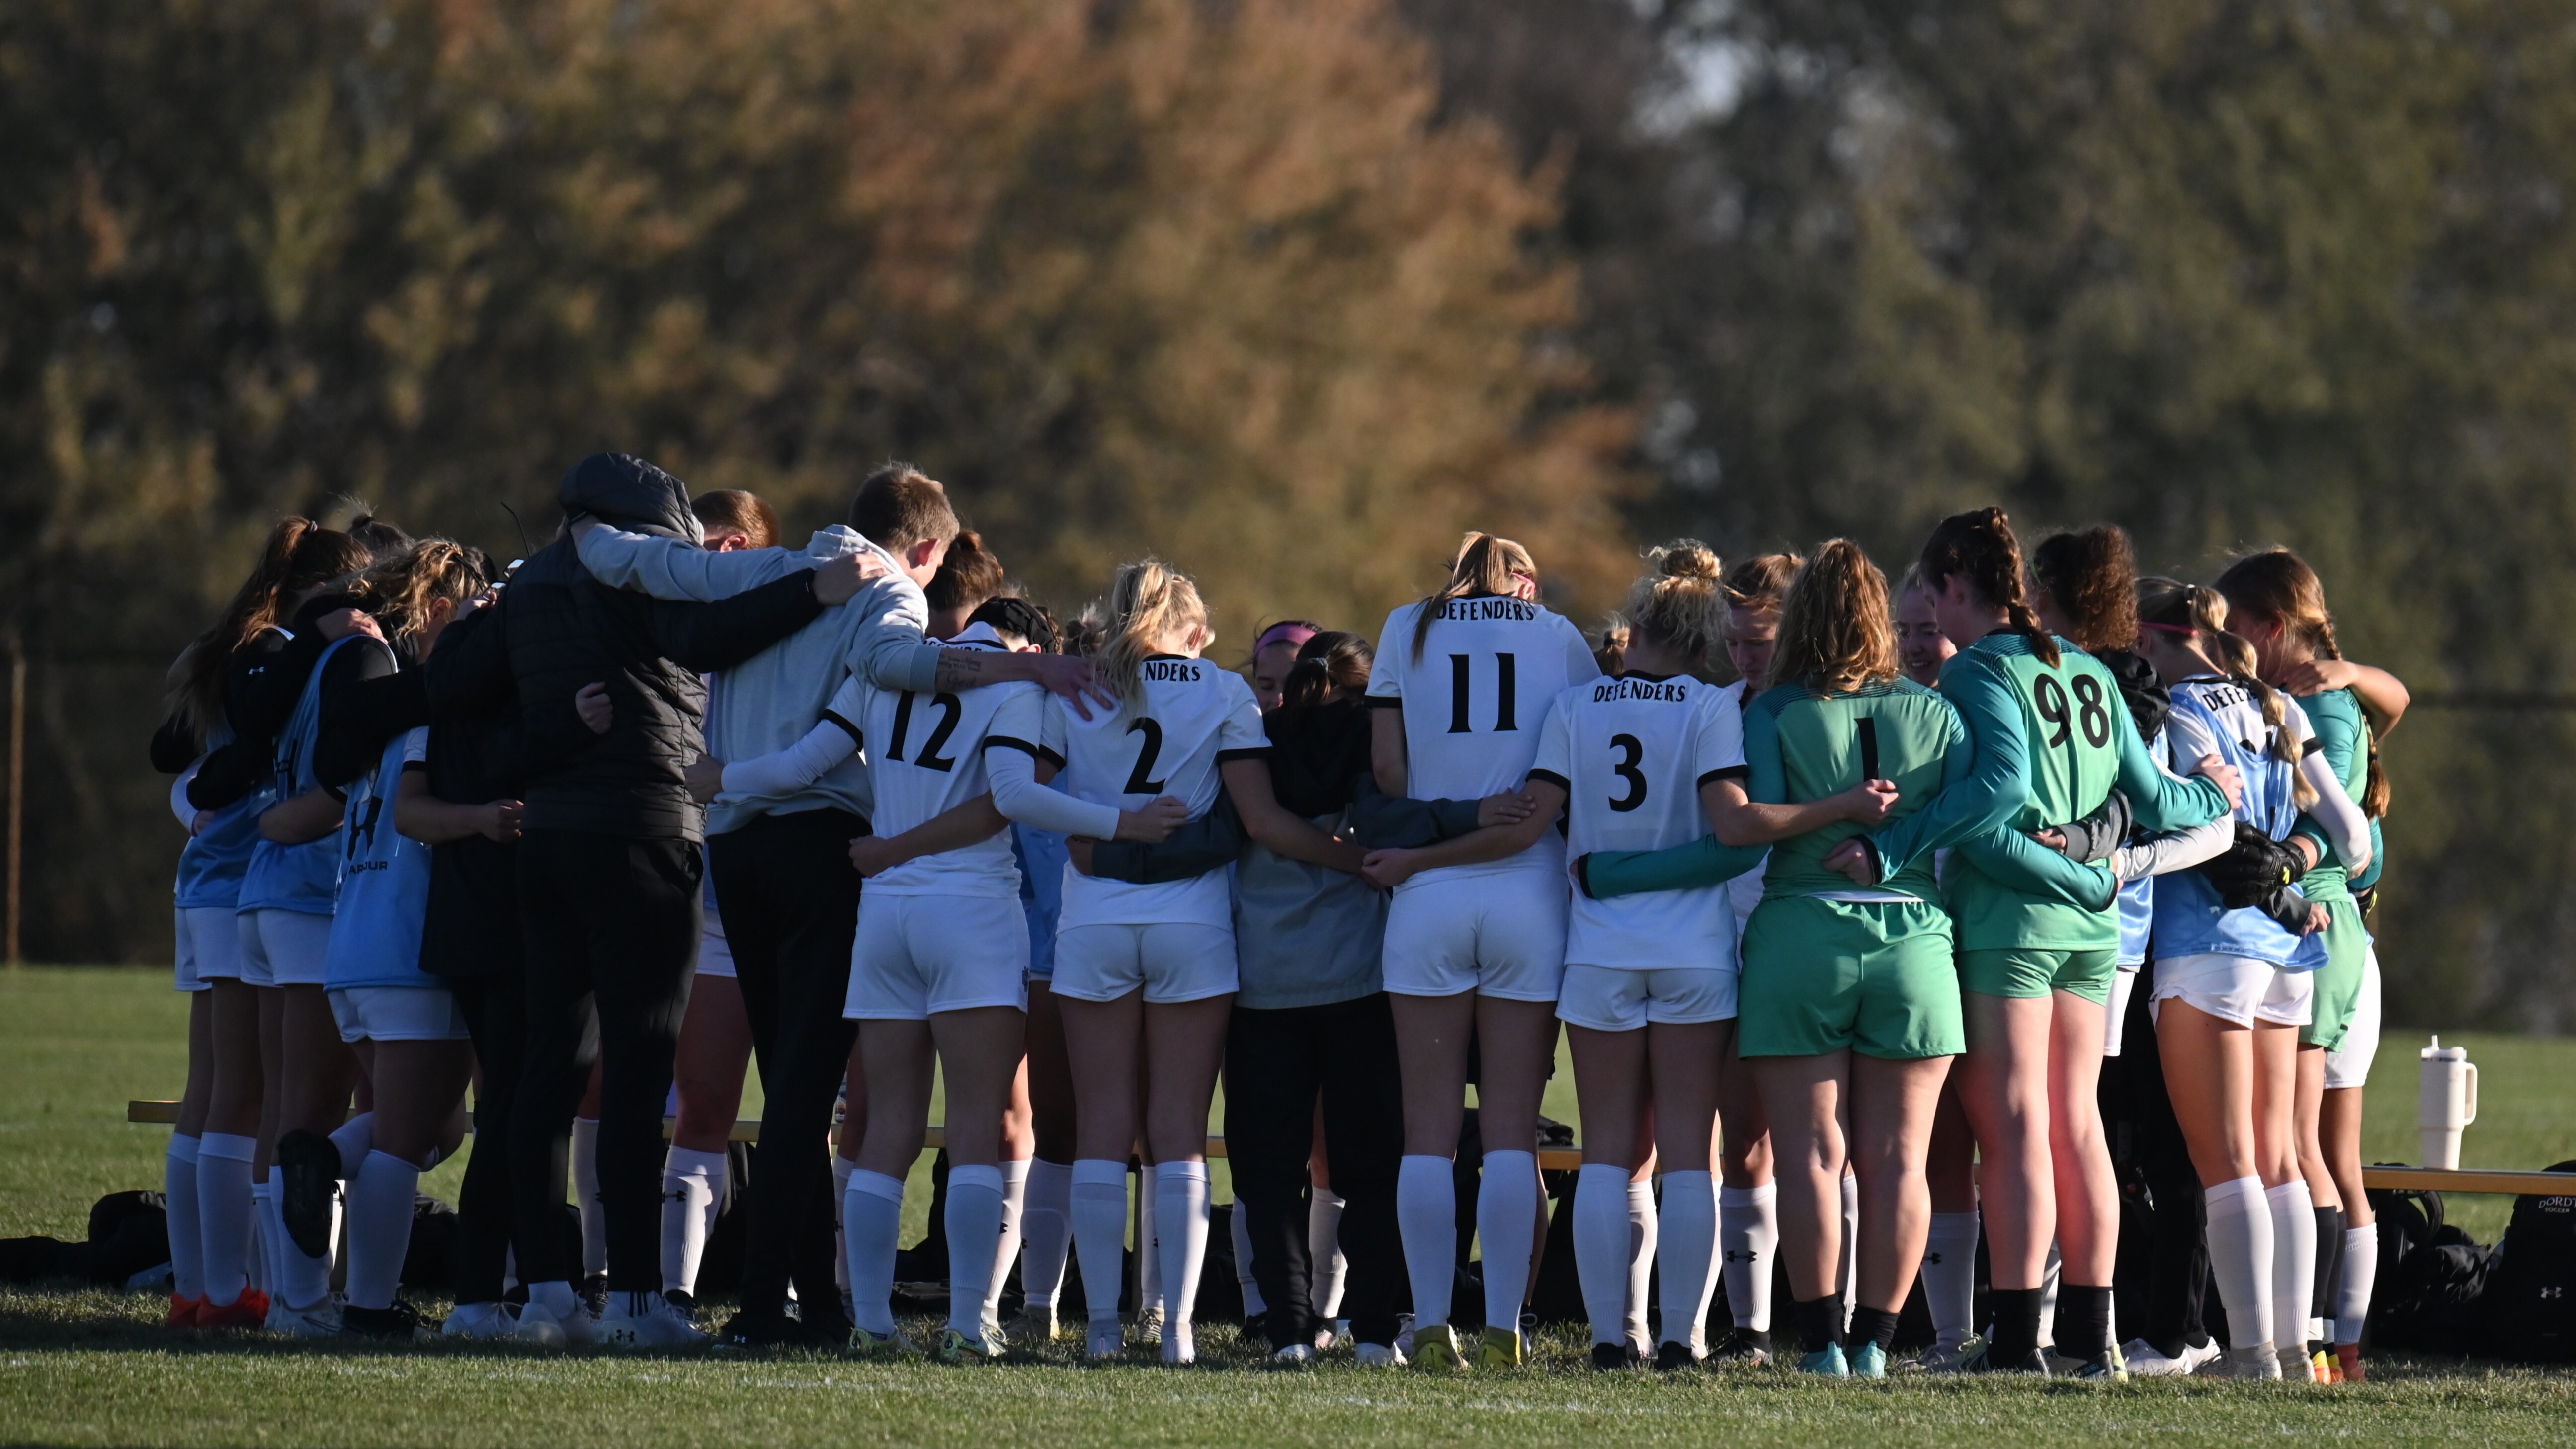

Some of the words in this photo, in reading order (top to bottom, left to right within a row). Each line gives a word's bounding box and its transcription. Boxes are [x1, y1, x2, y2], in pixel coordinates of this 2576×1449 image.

[1436, 600, 1534, 621] DEFENDERS
[1145, 662, 1201, 682] NDERS
[1447, 652, 1518, 733] 11
[1594, 680, 1686, 702] DEFENDERS
[886, 689, 961, 772] 12
[2034, 673, 2109, 749] 98
[1123, 717, 1166, 794] 2
[1608, 734, 1647, 812] 3
[1854, 717, 1880, 782] 1
[349, 861, 388, 874] ARUR
